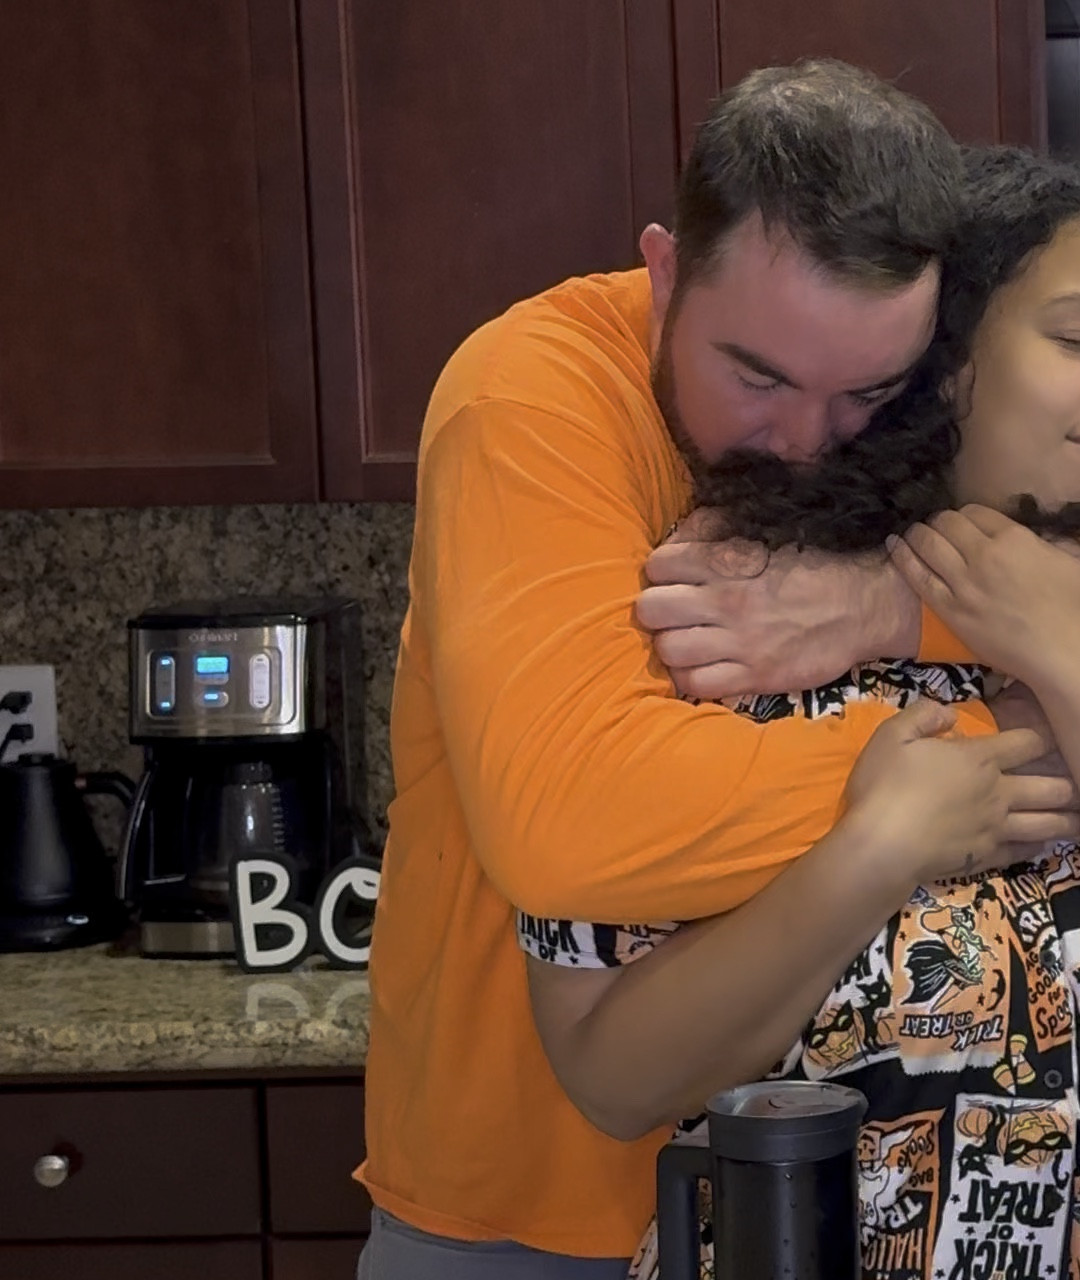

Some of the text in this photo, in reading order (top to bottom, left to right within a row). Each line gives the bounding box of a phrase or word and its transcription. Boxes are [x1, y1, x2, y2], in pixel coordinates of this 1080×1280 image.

[899, 1011, 974, 1038] OR TREAT
[951, 1014, 1004, 1051] TRICK
[957, 1178, 1058, 1228] TREAT
